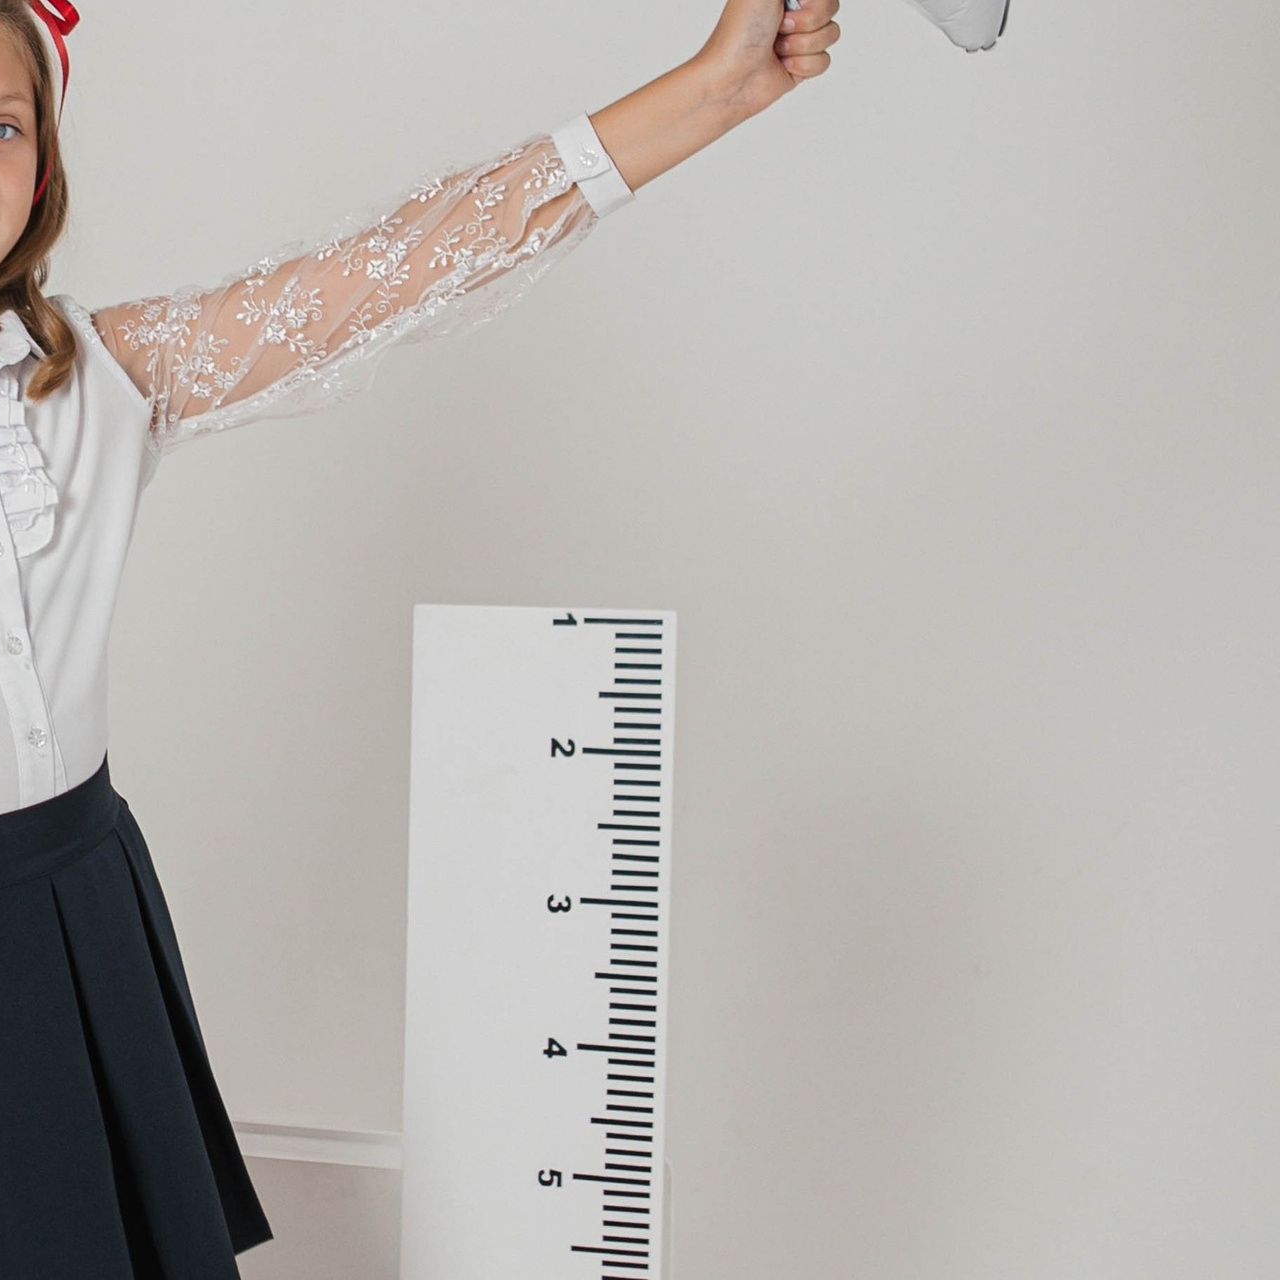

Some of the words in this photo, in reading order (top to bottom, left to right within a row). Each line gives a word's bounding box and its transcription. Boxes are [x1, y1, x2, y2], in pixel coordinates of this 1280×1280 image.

[552, 612, 578, 627] 1
[550, 737, 576, 758] 2
[547, 893, 572, 913] 3
[542, 1036, 568, 1059] 4
[537, 1168, 562, 1188] 5
